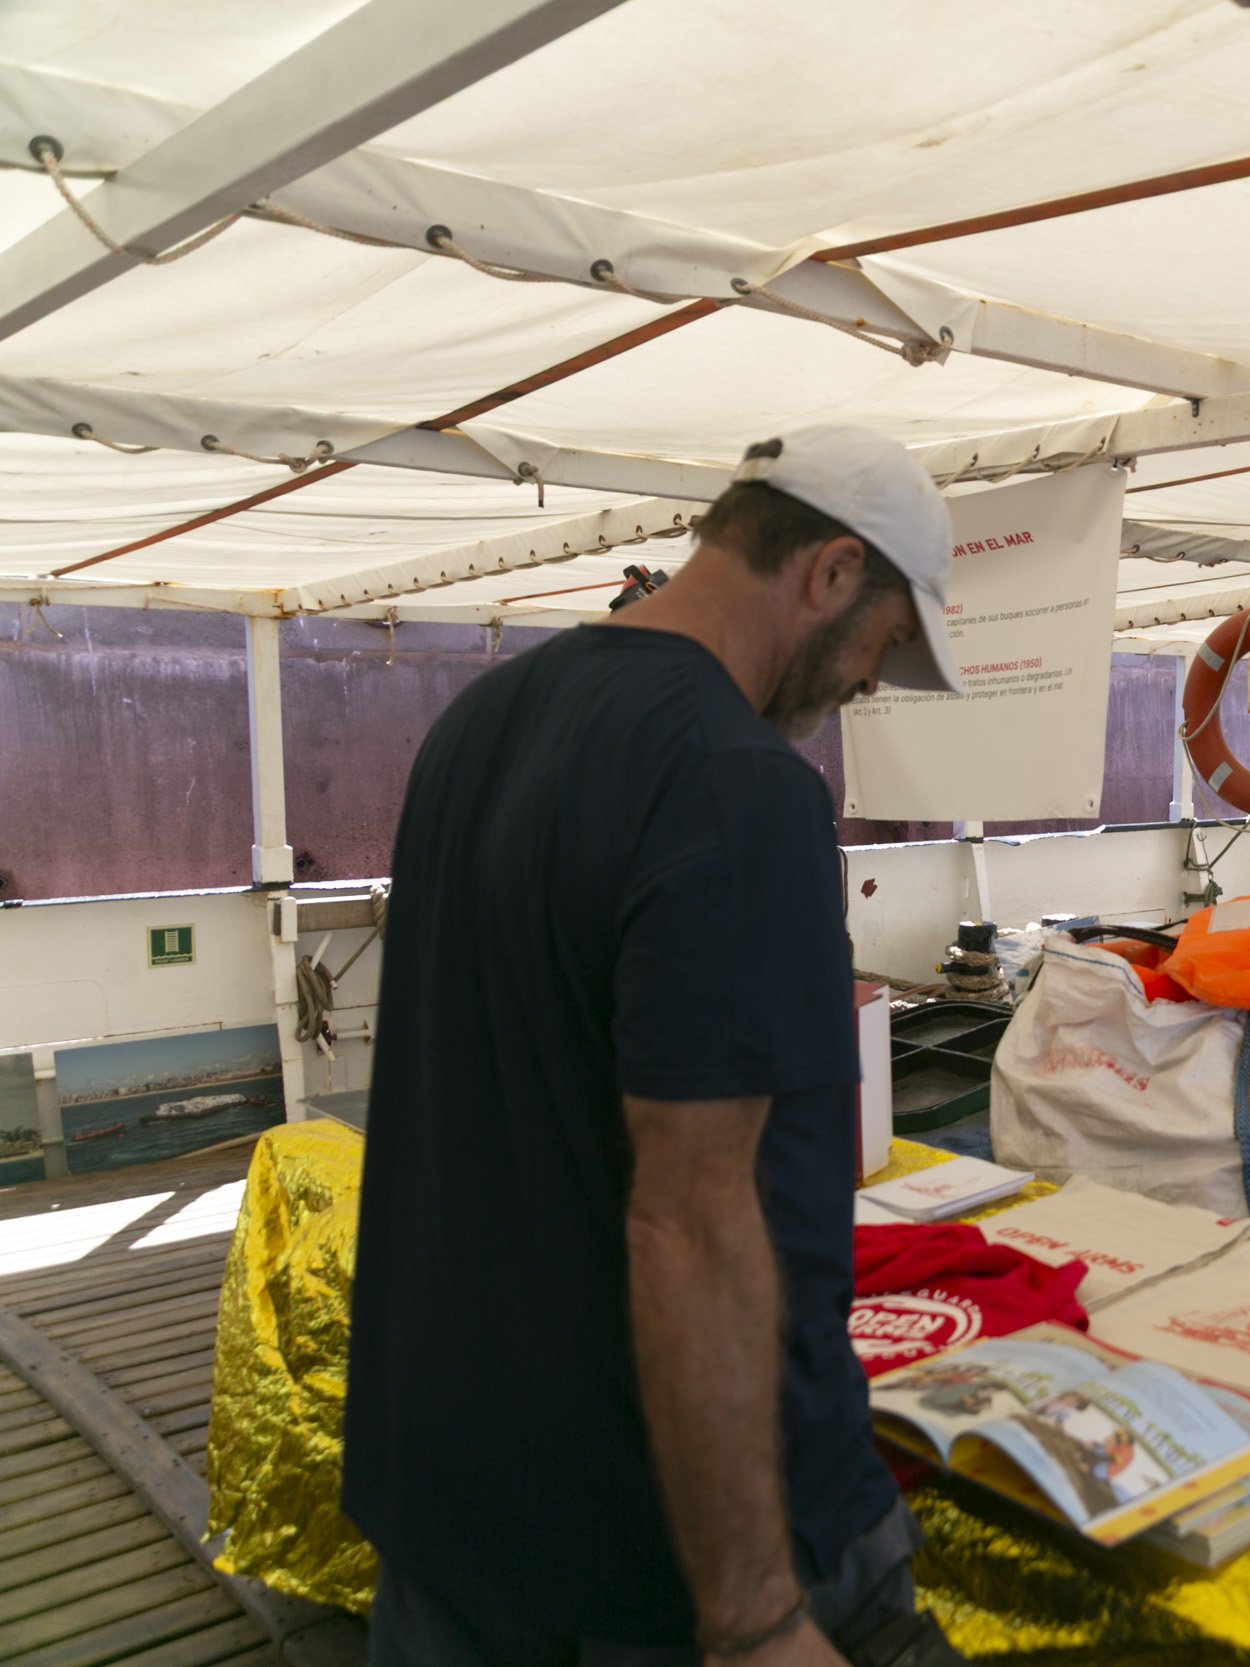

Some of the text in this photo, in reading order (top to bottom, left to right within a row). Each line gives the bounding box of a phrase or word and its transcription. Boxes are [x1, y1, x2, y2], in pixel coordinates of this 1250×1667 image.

[966, 541, 986, 555] EN
[985, 537, 1005, 551] EL
[1003, 531, 1034, 548] MAR
[942, 603, 963, 616] 1982)
[946, 615, 977, 628] capitanes
[978, 614, 987, 624] de
[988, 613, 999, 622] sus
[1000, 610, 1024, 622] buques
[980, 660, 1019, 674] HUMANOS
[1020, 656, 1043, 671] (1950)
[900, 692, 935, 704] obligación
[936, 692, 944, 701] de
[971, 689, 999, 700] proteger
[1008, 685, 1032, 696] frontera
[996, 1226, 1145, 1275] OPEN ARMS
[847, 1308, 947, 1336] OPEN
